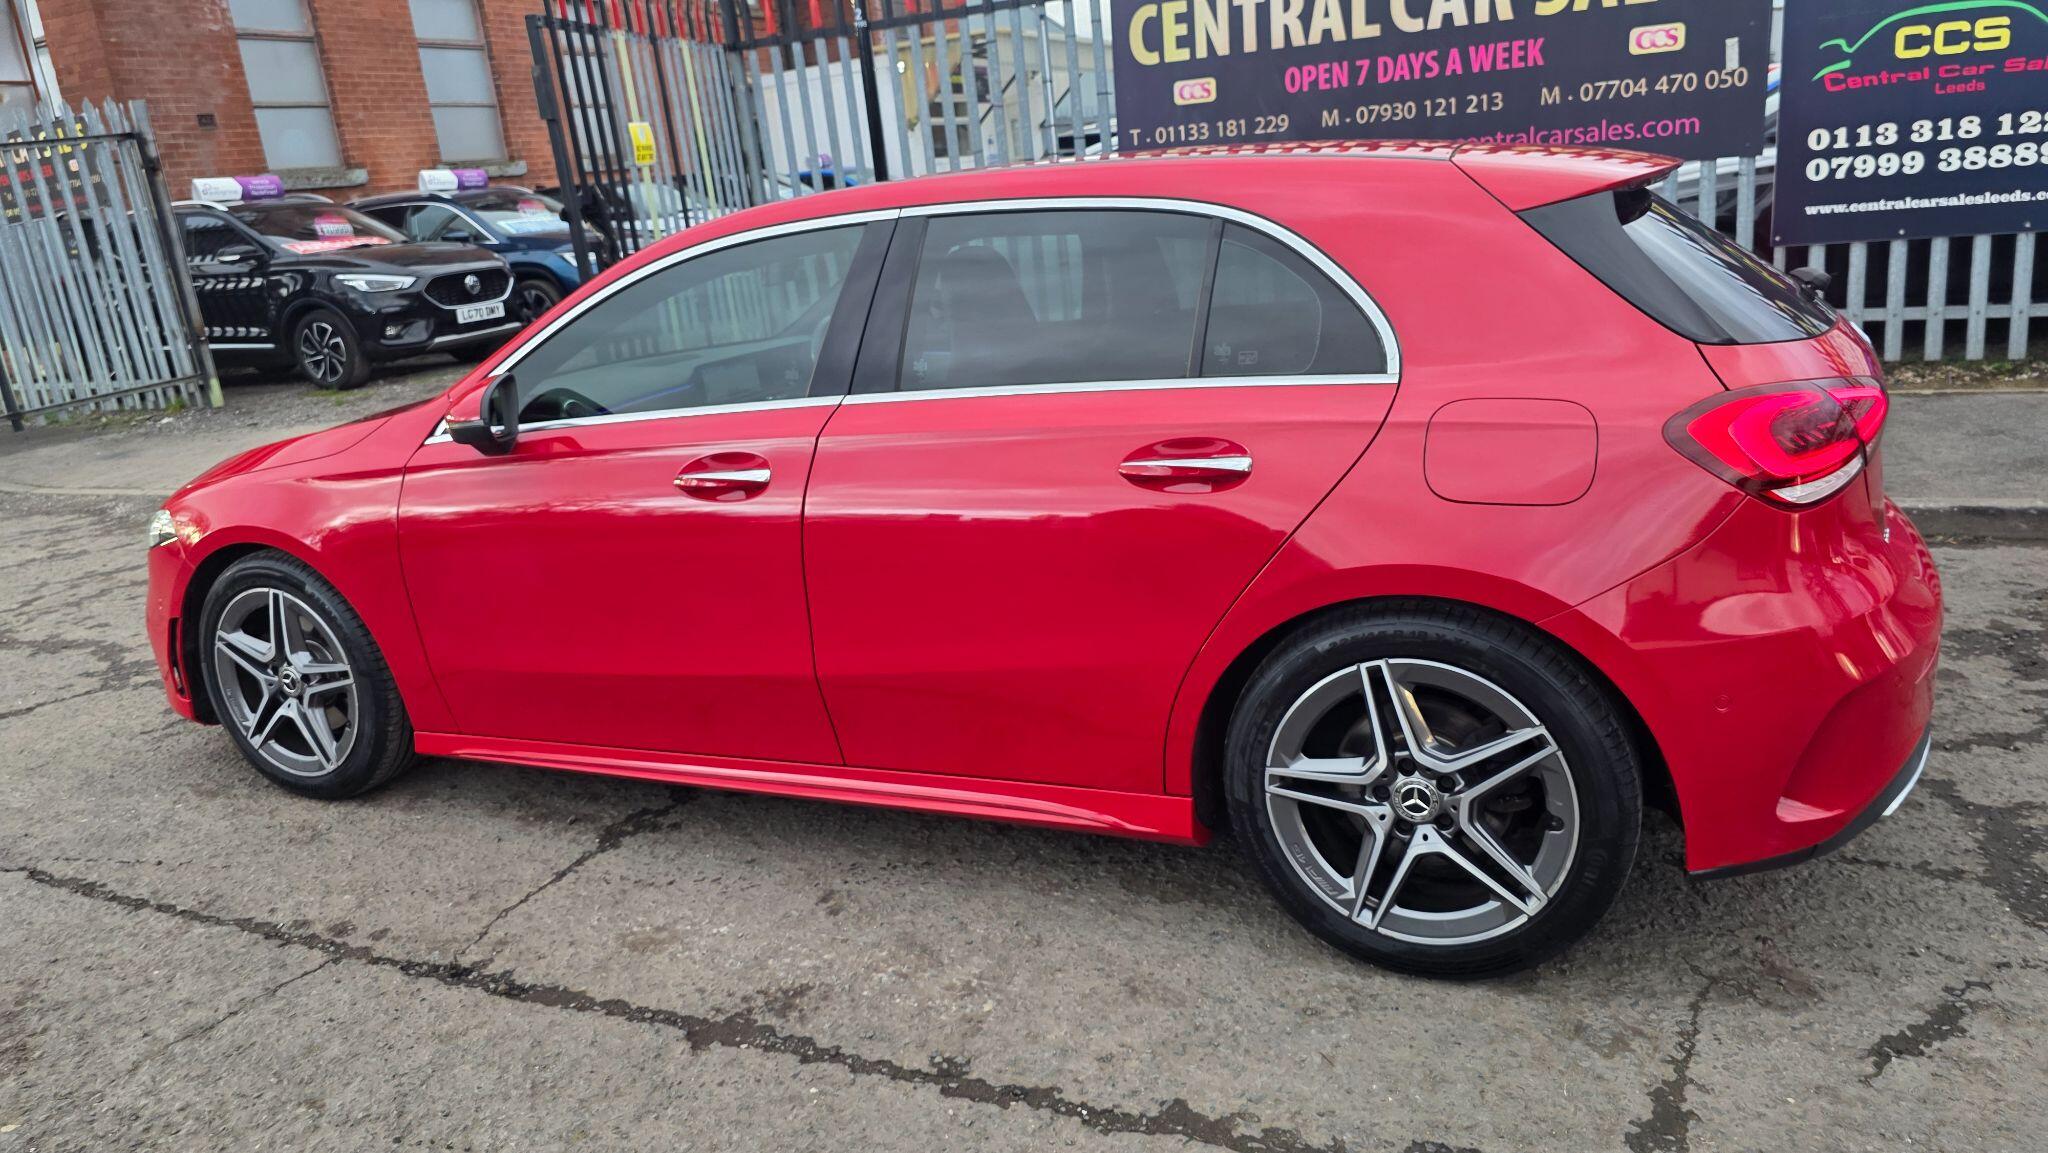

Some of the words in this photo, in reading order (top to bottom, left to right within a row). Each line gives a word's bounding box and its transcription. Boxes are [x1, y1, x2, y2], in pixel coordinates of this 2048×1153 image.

[1129, 0, 1381, 66] CENTRAL
[1894, 16, 2011, 59] CCS
[1284, 66, 1349, 94] OPEN
[1355, 58, 1371, 86] 7
[1377, 50, 1440, 84] DAYS
[1445, 47, 1463, 76] A
[1468, 37, 1545, 73] WEEK
[1823, 66, 1930, 93] Central
[1938, 63, 1995, 79] Car
[1580, 77, 1648, 102] 07704
[1654, 72, 1698, 94] 470
[1704, 66, 1749, 90] 050
[1935, 79, 1986, 95] Leeds
[1355, 101, 1417, 125] 07930
[1423, 97, 1457, 117] 121
[1465, 91, 1504, 113] 213
[1155, 121, 1209, 144] 01133
[1216, 119, 1246, 138] 181
[1254, 113, 1290, 135] 229
[1807, 122, 1898, 151] 0113
[1910, 115, 1982, 143] 318
[1997, 110, 2048, 136] 12
[1805, 150, 1925, 182] 07999
[1804, 189, 2048, 216] www.centralcarsalesleeds.c
